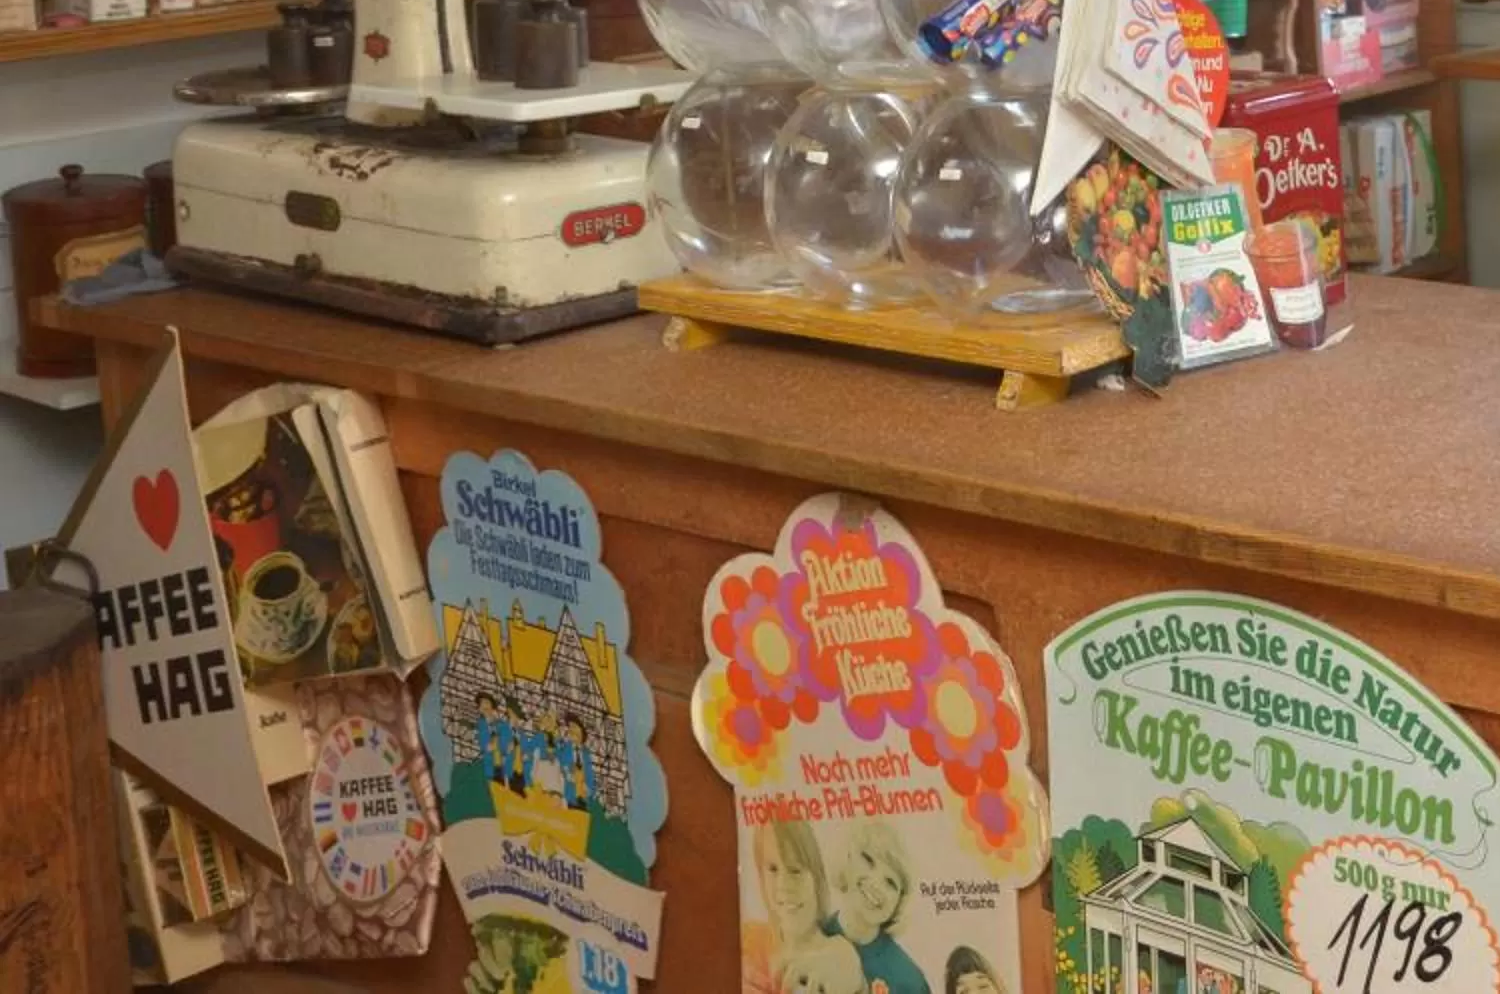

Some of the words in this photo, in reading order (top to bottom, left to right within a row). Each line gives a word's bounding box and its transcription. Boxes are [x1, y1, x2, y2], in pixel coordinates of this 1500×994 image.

[1297, 127, 1325, 153] A.
[1256, 157, 1338, 209] Oetker's
[574, 213, 634, 238] BERKEL
[1174, 218, 1235, 242] Gelfix
[490, 469, 537, 498] Birkel
[456, 479, 582, 548] Schwäbli
[564, 555, 592, 582] zum
[801, 549, 888, 601] Aktion
[94, 566, 218, 651] AFFEE
[802, 599, 913, 658] Fröhliche
[131, 649, 236, 724] HAG
[835, 648, 913, 706] Küche
[1081, 613, 1232, 681] Genießen
[1237, 616, 1288, 667] Sie
[1295, 638, 1352, 696] die
[1354, 670, 1462, 778] Natur
[1168, 656, 1217, 705] im
[1222, 675, 1359, 745] eigenen
[339, 775, 394, 798] KAFFEE
[800, 749, 855, 785] Noch
[857, 745, 912, 780] mehr
[1093, 688, 1457, 845] Kaffee-Pavillon
[362, 797, 398, 818] HAG
[740, 791, 822, 827] fröhliche
[822, 784, 944, 821] Pril-Blumen
[501, 839, 585, 890] Schwäbli
[1333, 857, 1379, 892] 500
[1400, 880, 1451, 912] nur
